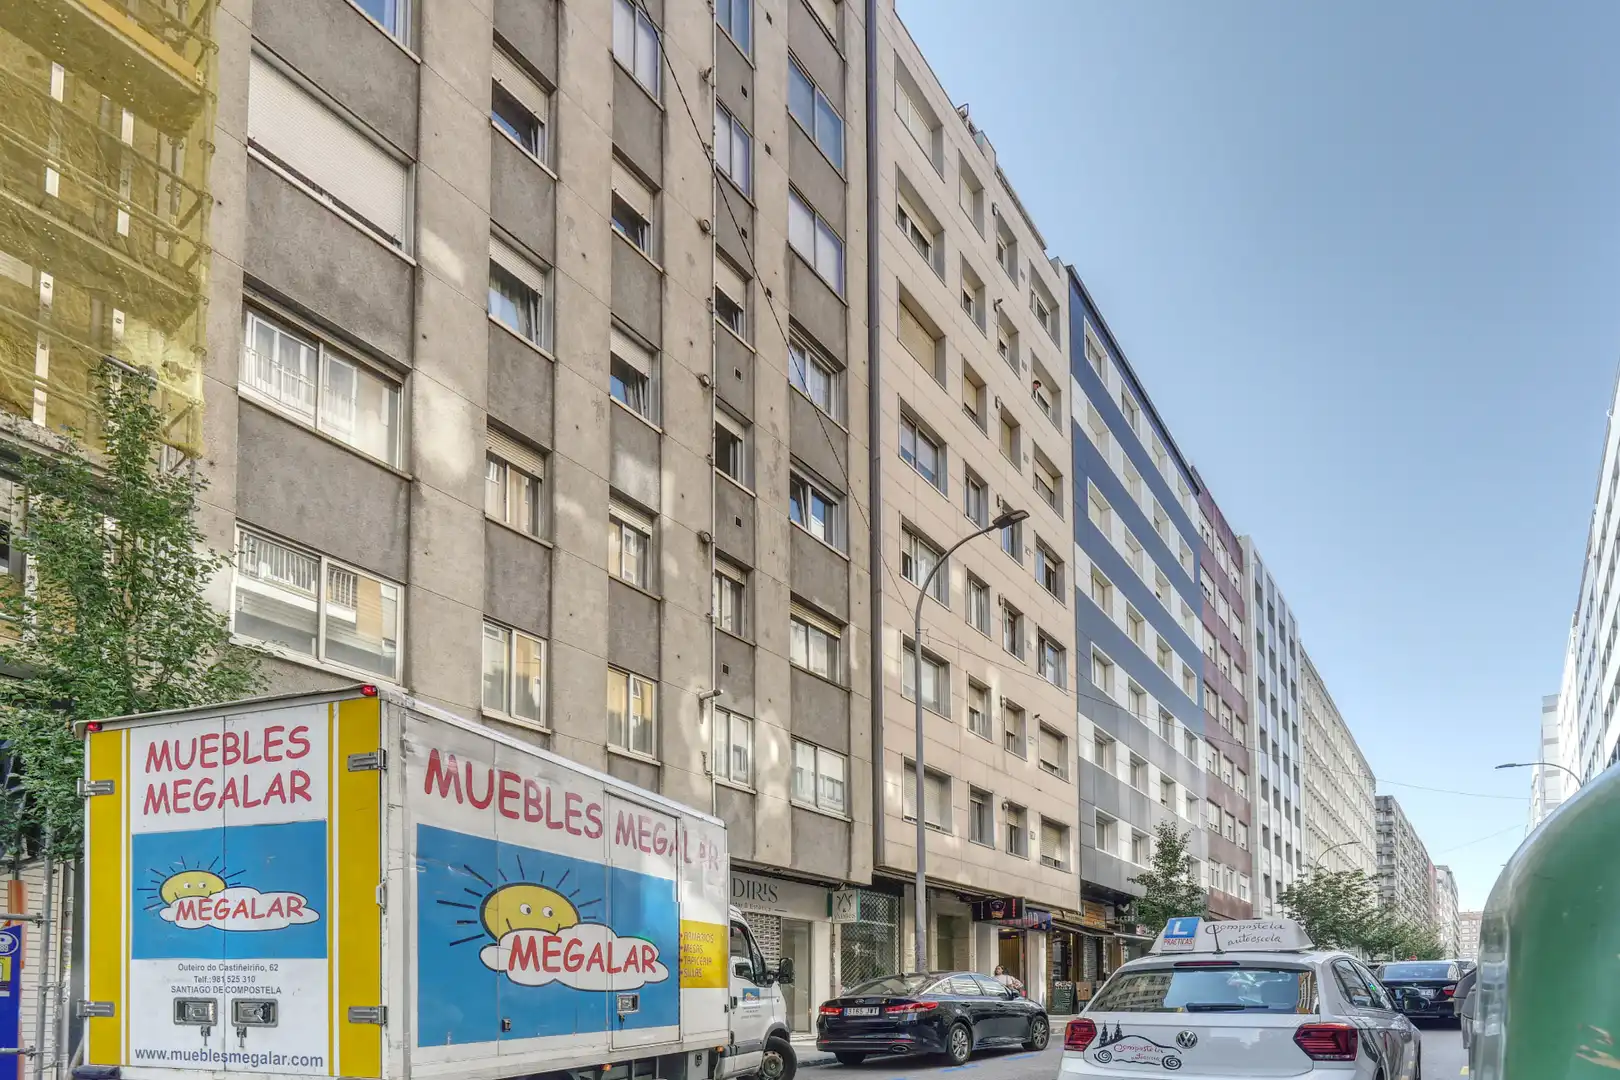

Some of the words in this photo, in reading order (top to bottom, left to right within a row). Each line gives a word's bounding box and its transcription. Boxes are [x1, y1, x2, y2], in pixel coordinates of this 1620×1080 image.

[145, 725, 311, 774] MUEBLES
[143, 769, 312, 816] MEGALAR
[424, 747, 603, 840] MUEBLES
[732, 878, 778, 903] DIRIS
[175, 896, 304, 922] MEGALAR
[1172, 920, 1189, 936] L
[1205, 921, 1286, 935] Compostela
[508, 934, 658, 974] MEGALAR
[683, 944, 704, 954] MESAS
[177, 963, 205, 972] Outeiro
[207, 963, 217, 972] do
[218, 963, 268, 973] Castiñeiriño,
[269, 963, 279, 972] 62
[683, 968, 703, 978] SILLAS
[227, 975, 241, 983] 525
[242, 975, 256, 983] 310
[171, 985, 211, 994] SANTIAGO
[225, 985, 282, 995] COMPOSTELA
[1113, 1043, 1165, 1054] Compostela
[135, 1047, 324, 1068] www.mueblesmegalar.com
